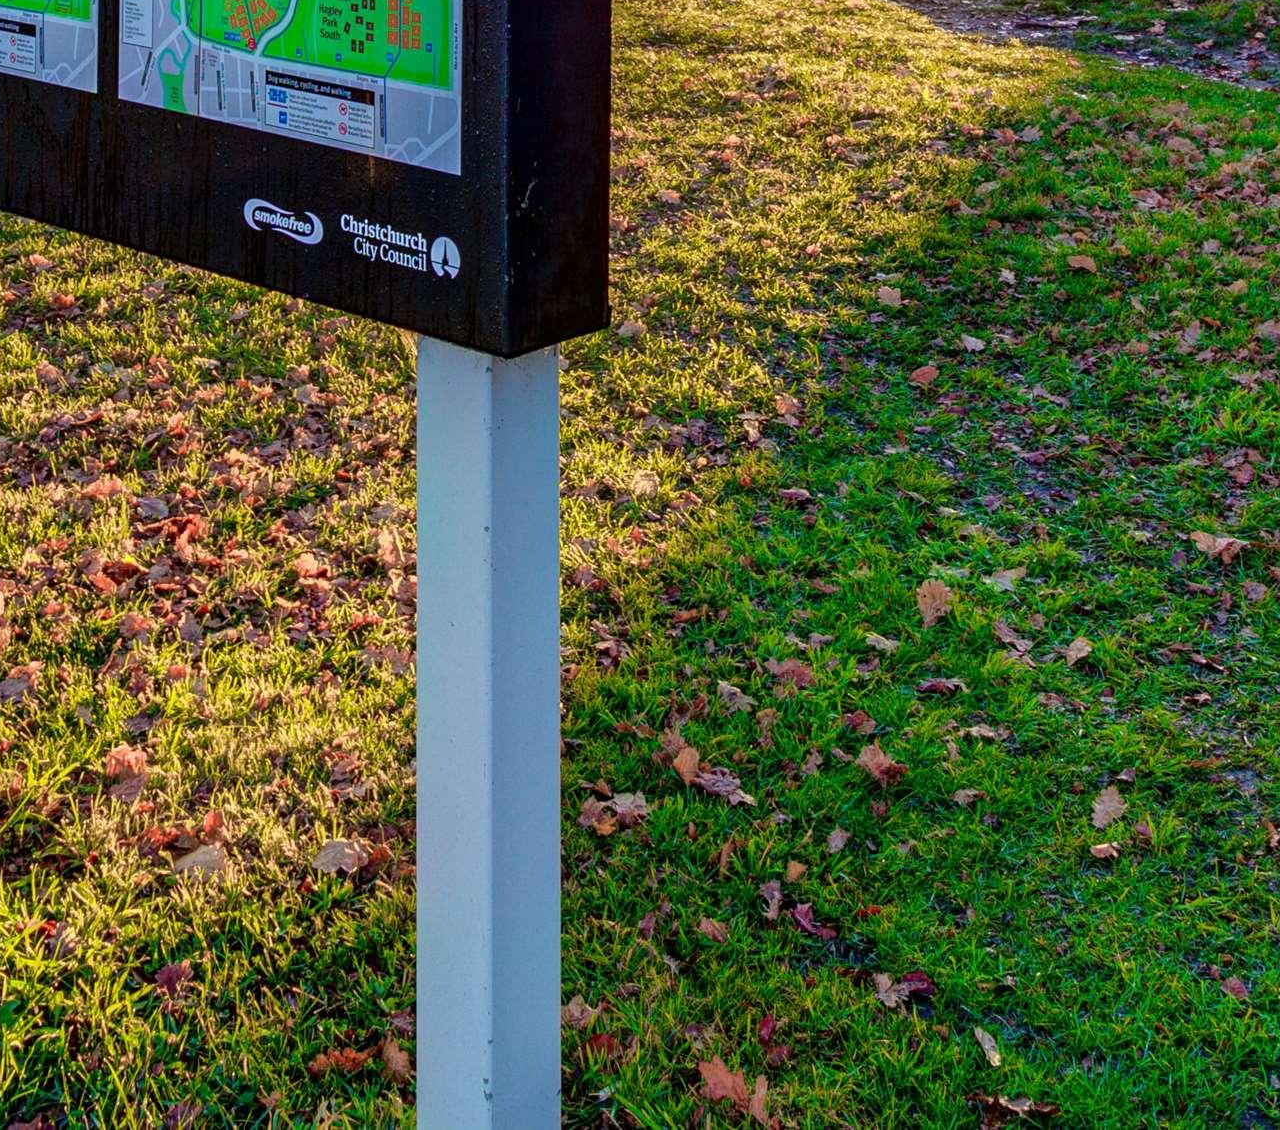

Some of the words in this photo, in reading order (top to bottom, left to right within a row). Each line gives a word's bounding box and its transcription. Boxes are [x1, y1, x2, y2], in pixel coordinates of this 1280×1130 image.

[319, 2, 342, 18] Hagley
[319, 29, 341, 40] South
[322, 17, 338, 28] Park
[267, 74, 277, 84] Dog
[300, 81, 319, 92] cycling,
[320, 85, 331, 93] and
[331, 88, 352, 99] walking
[253, 210, 312, 234] smokefree
[340, 214, 428, 252] Christchurch
[354, 237, 378, 262] City
[380, 245, 428, 271] Council
